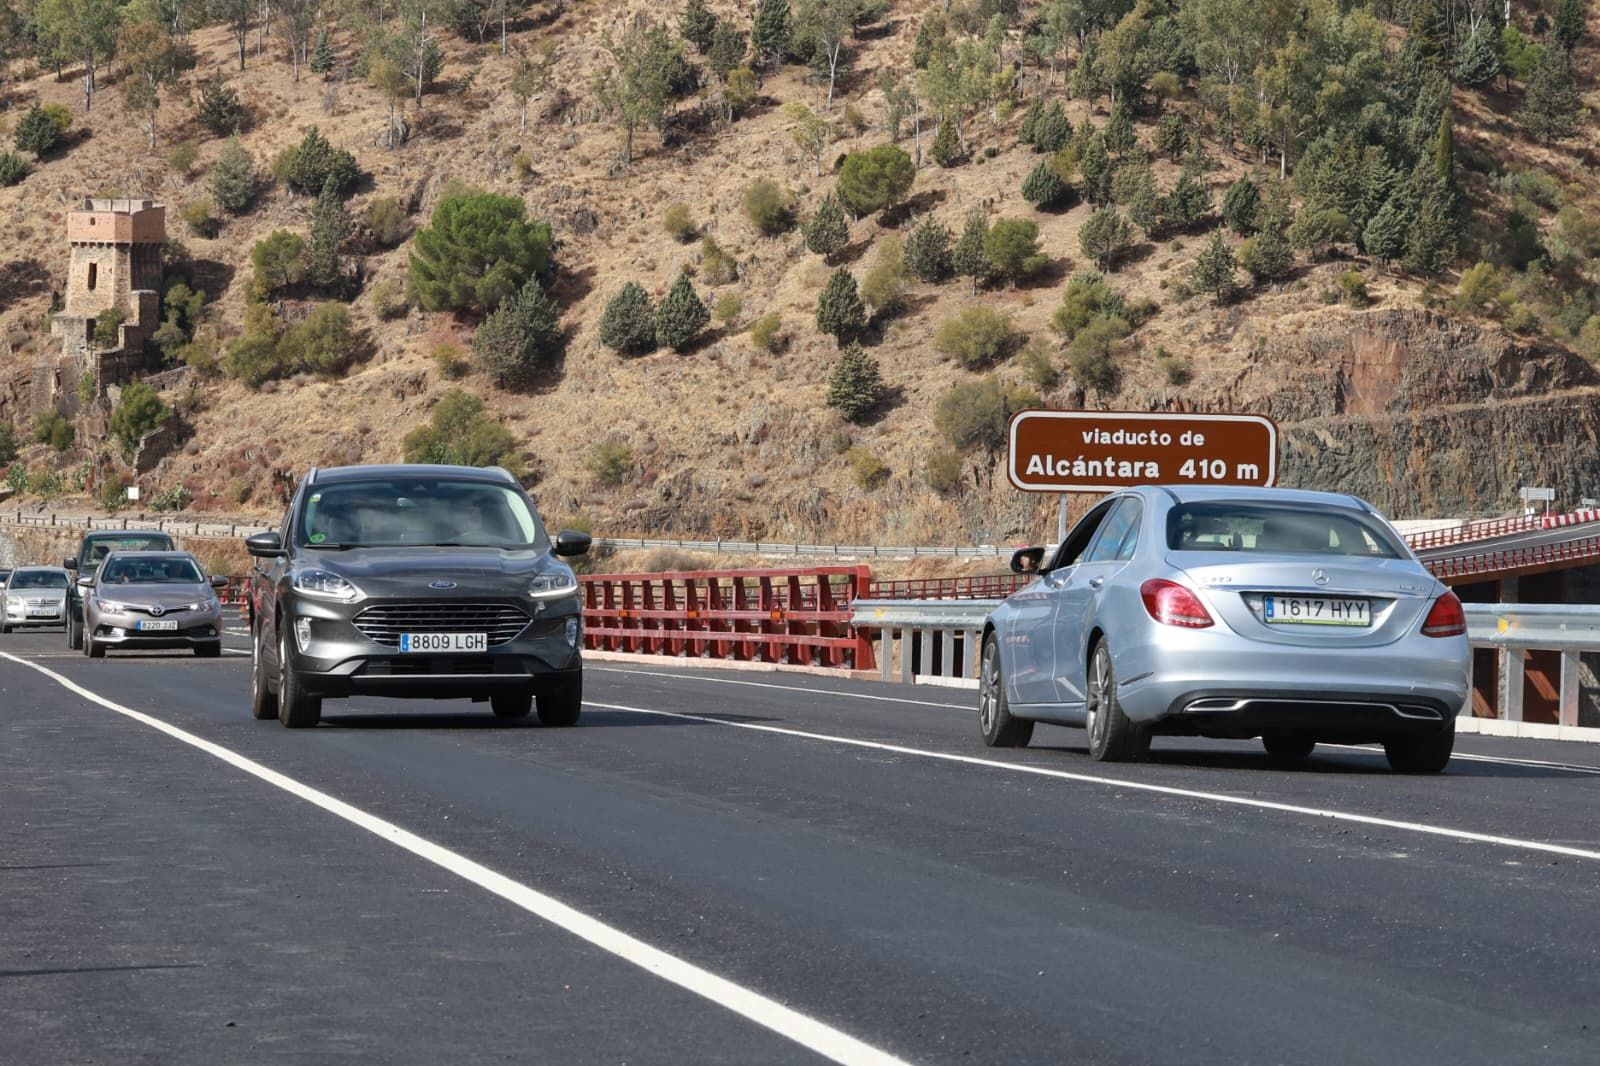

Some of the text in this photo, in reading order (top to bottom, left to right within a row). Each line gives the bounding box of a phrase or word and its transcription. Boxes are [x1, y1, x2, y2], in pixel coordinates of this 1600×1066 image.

[1082, 428, 1205, 446] viaducto de
[1026, 454, 1259, 480] Alcántara 410 m
[1280, 599, 1365, 619] 1617 HYY
[412, 635, 484, 649] 8809 LGH
